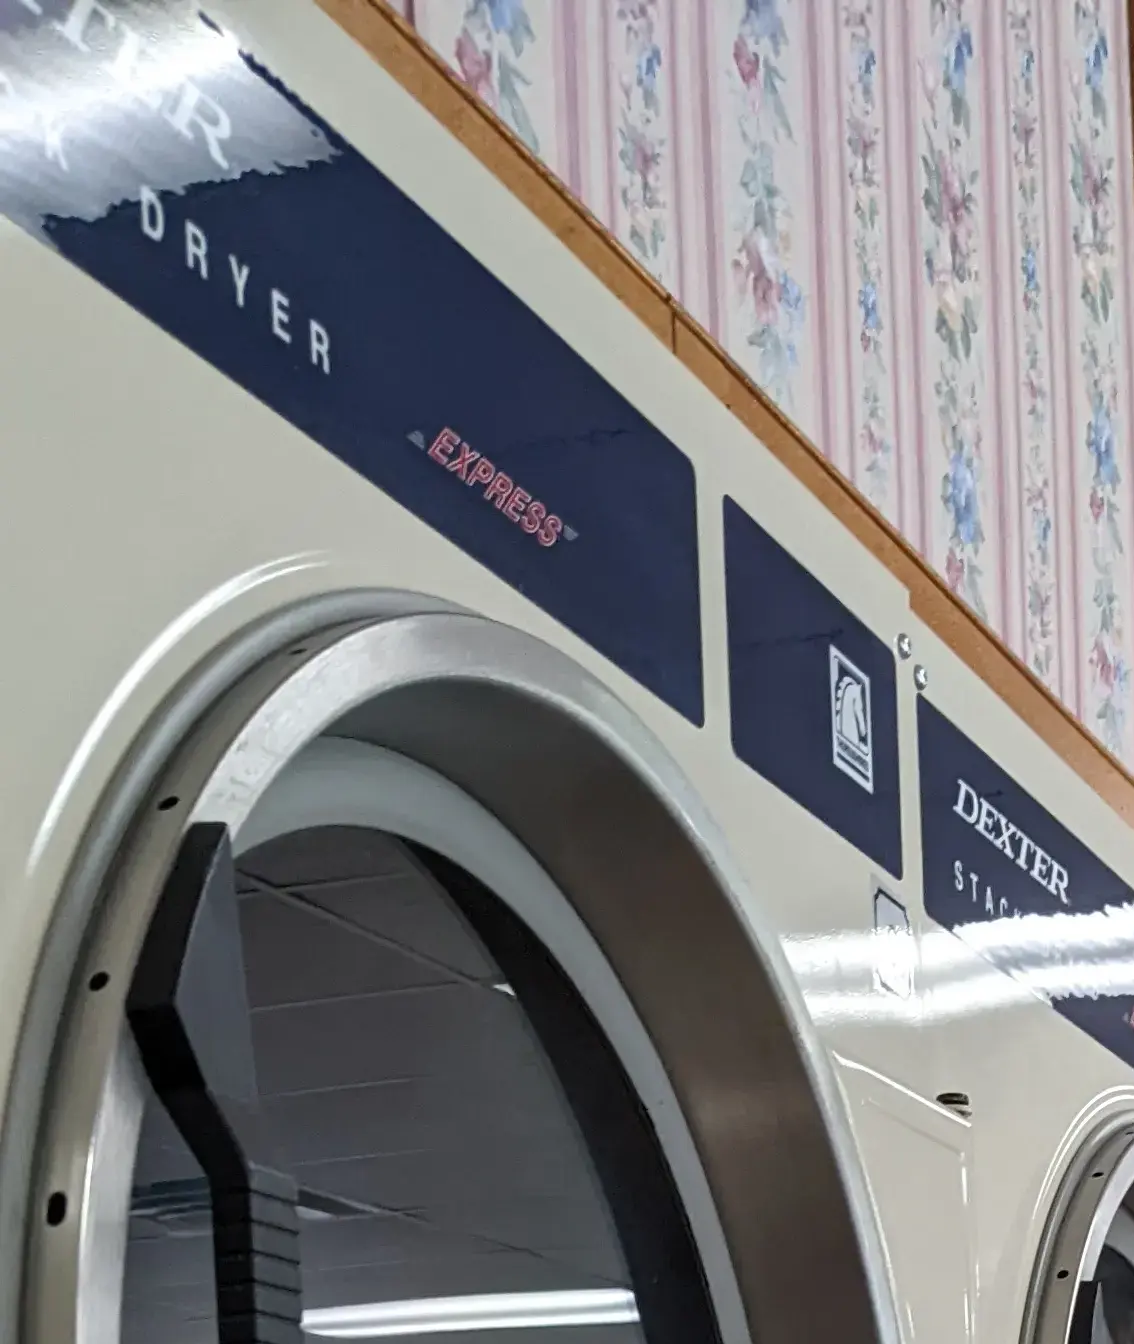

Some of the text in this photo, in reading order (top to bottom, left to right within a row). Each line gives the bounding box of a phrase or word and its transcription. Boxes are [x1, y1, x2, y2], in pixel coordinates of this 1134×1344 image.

[140, 185, 331, 375] DRYER
[427, 426, 563, 547] EXPRESS
[952, 778, 1070, 906] DEXTER
